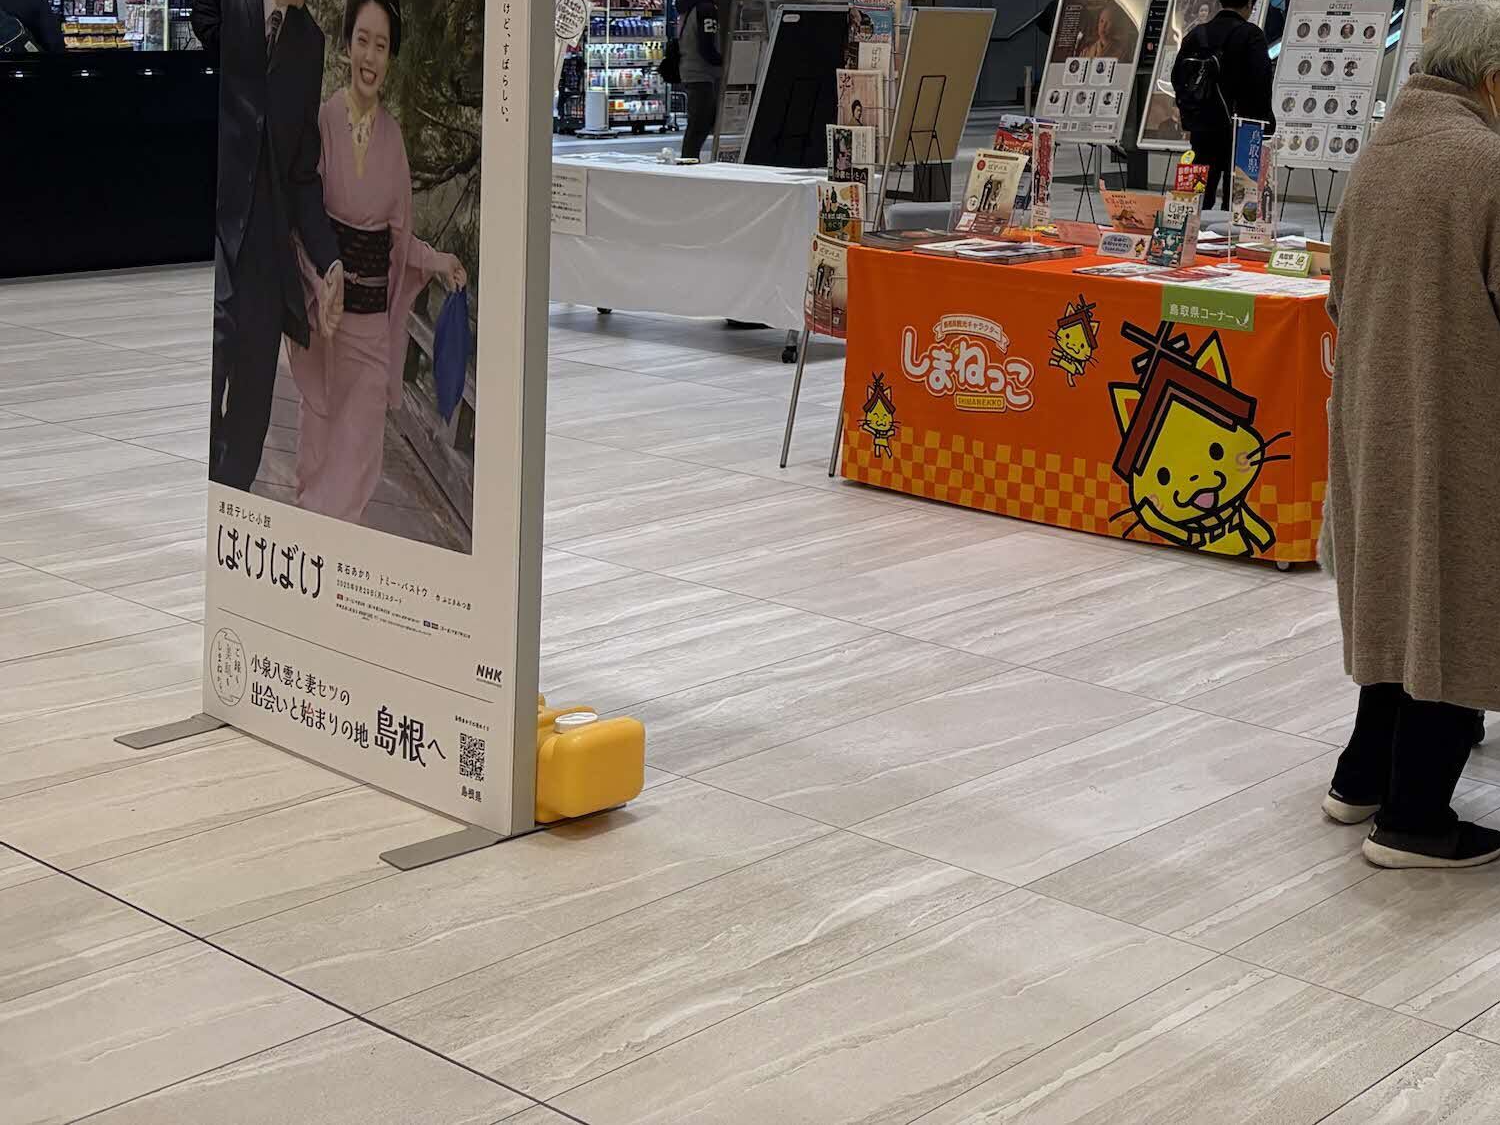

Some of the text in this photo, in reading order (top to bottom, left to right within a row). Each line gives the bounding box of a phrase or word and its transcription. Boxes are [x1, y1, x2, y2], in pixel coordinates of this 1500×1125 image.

[1248, 130, 1261, 172] 鳥取県
[1169, 303, 1235, 322] 鳥取県コーナー
[902, 327, 1034, 410] しまねっこ
[957, 397, 1003, 408] SHIMANEKKO
[219, 501, 271, 528] 連続テレビ小説
[217, 524, 324, 599] ばけばけ
[251, 654, 350, 706] 小泉八雲と妻セツの
[476, 664, 502, 682] NHK
[251, 682, 447, 767] 出会いと始まりの地 島根へ
